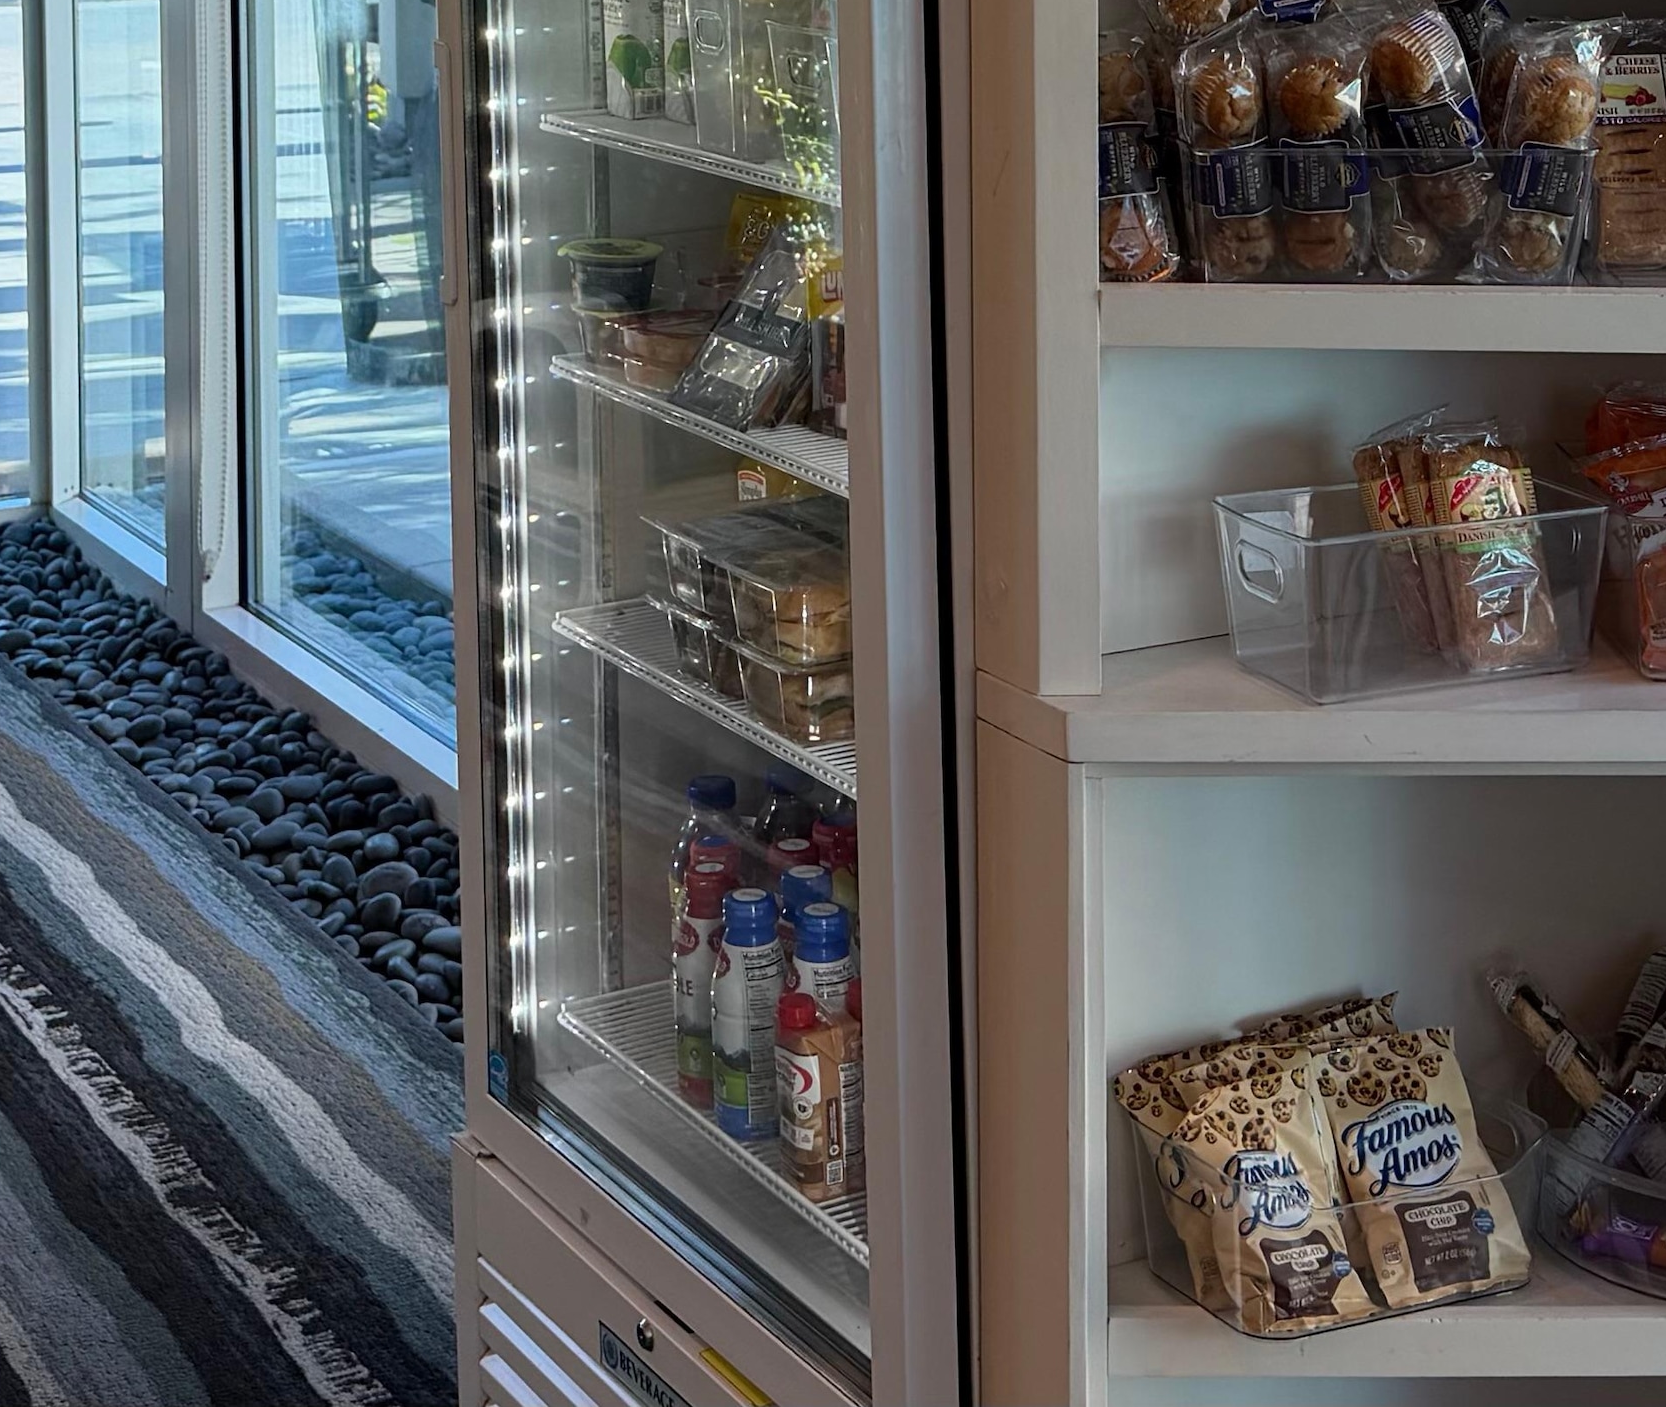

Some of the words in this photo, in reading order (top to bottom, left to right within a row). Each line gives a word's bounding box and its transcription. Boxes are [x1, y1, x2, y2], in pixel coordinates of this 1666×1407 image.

[1615, 66, 1660, 74] BERRIES
[1616, 57, 1657, 65] CHEESE
[1458, 530, 1496, 543] DANISH
[1341, 1103, 1455, 1176] Famous
[1369, 1133, 1455, 1197] Amos
[1220, 1151, 1298, 1210] Famous
[1239, 1180, 1311, 1237] Amos
[1408, 1201, 1466, 1221] CHOCOLATE
[1430, 1216, 1453, 1226] CHIP
[1274, 1245, 1327, 1262] CHOCOLATE
